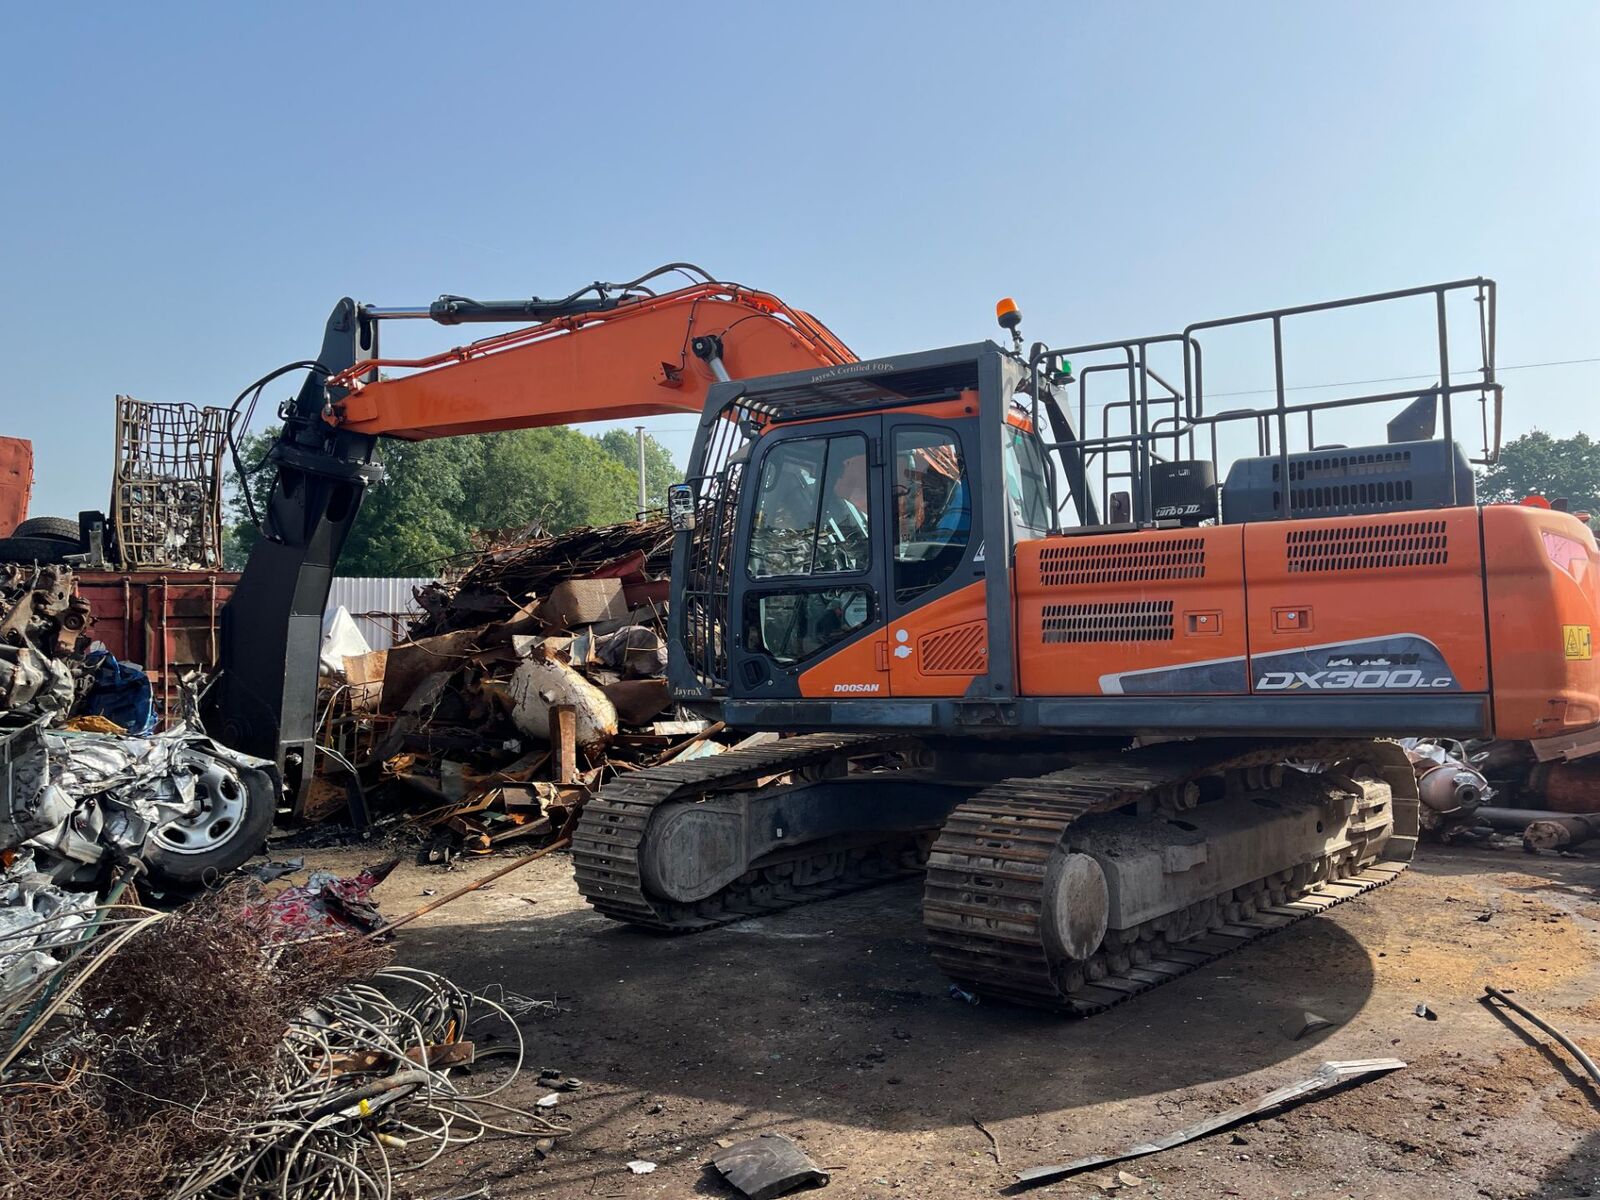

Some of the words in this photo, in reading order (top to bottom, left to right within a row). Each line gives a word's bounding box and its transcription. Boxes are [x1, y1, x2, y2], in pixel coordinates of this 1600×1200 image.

[837, 364, 870, 375] Certified
[673, 687, 703, 698] JayroX
[833, 683, 880, 692] DOOSAN
